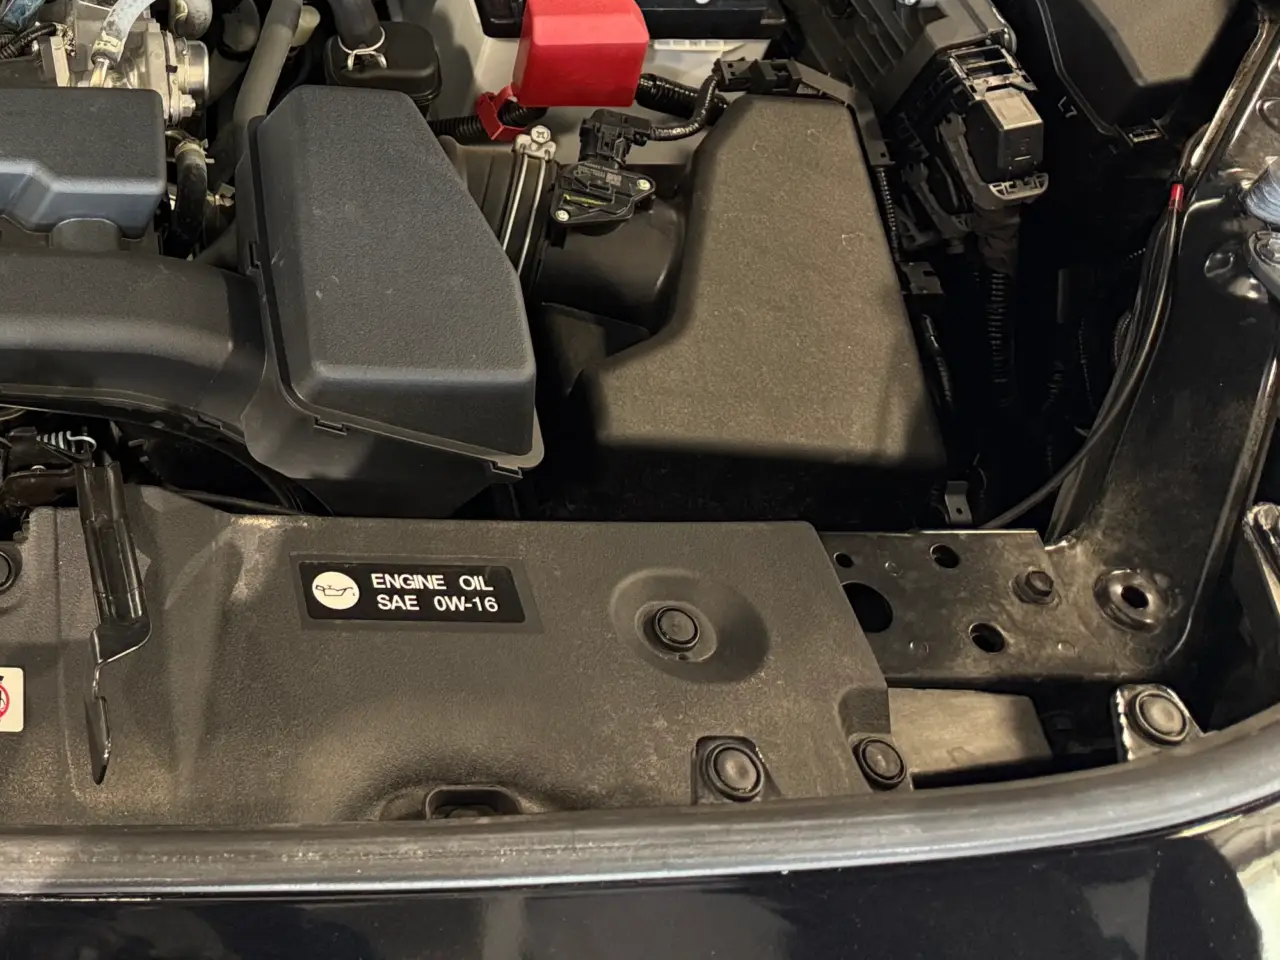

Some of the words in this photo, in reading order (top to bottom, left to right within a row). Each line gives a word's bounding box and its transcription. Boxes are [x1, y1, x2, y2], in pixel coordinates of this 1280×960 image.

[371, 573, 447, 590] ENGINE
[459, 575, 494, 591] OIL
[377, 595, 420, 611] SAE
[433, 595, 499, 612] 0W-16
